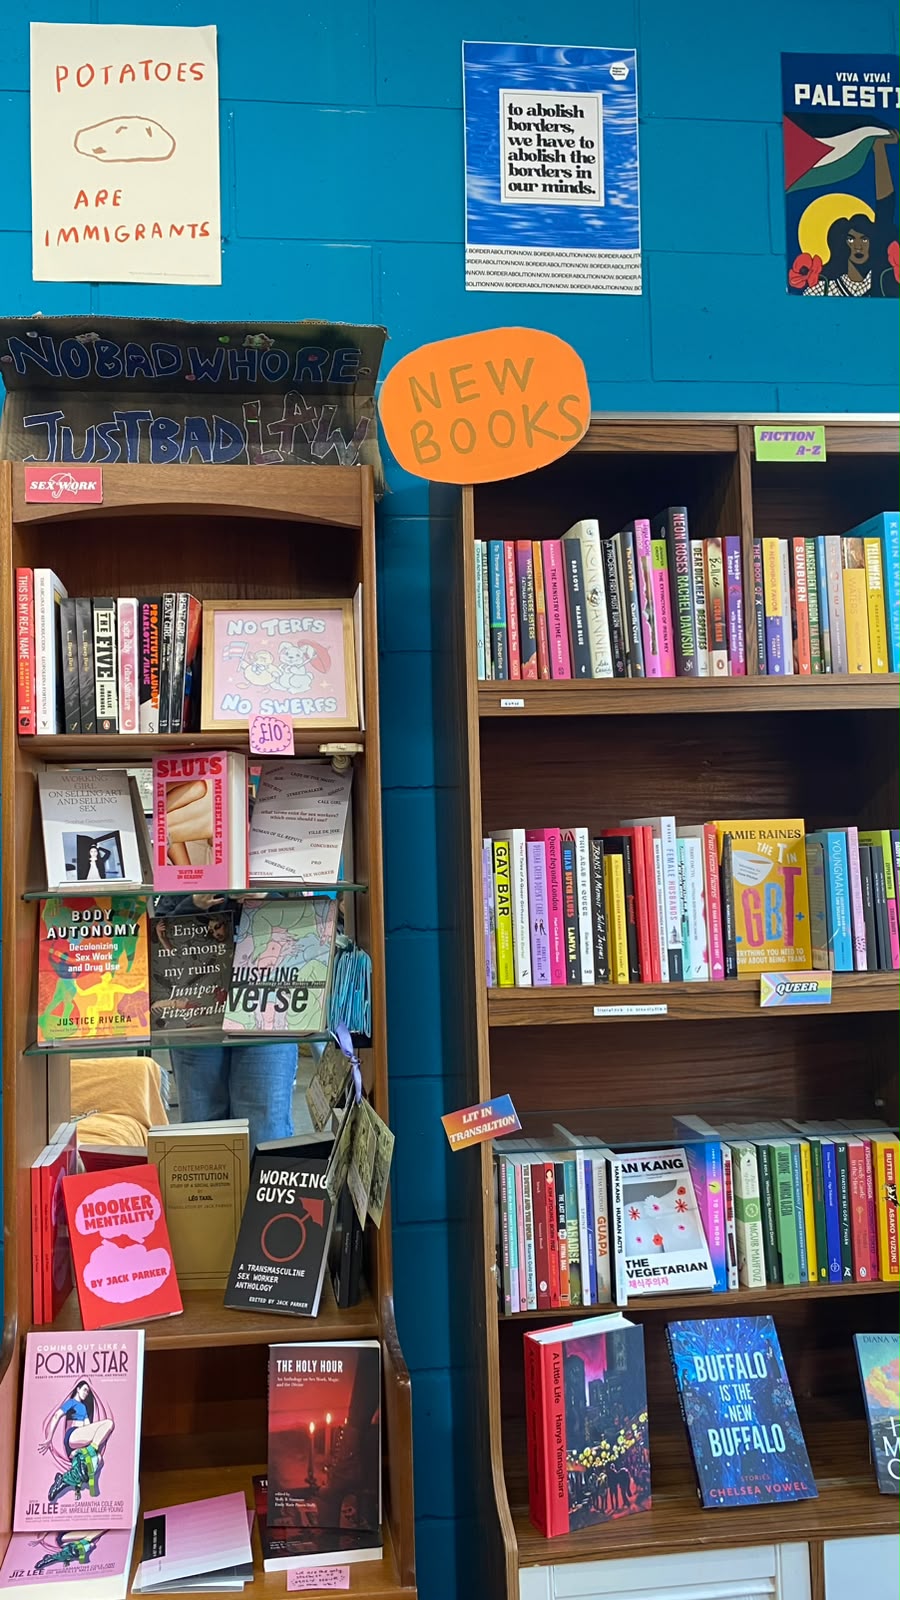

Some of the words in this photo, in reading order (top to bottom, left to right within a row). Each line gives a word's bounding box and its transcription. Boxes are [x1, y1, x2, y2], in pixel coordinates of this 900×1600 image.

[56, 59, 206, 93] POTATOES
[835, 72, 859, 82] VIVA
[863, 72, 891, 83] VIVA!
[507, 103, 523, 116] to
[526, 103, 585, 119] abolish
[507, 118, 575, 134] borders,
[507, 136, 533, 148] we
[535, 134, 576, 149] have
[578, 135, 595, 150] to
[507, 148, 566, 164] abolish
[569, 150, 597, 165] the
[507, 163, 573, 180] borders
[574, 165, 593, 180] in
[507, 181, 539, 193] our
[541, 180, 597, 196] minds.
[74, 189, 124, 210] ARE
[45, 221, 211, 247] IMMIGRANTS
[187, 347, 361, 383] WHORE
[408, 357, 535, 413] NEW
[242, 390, 372, 466] LAW
[410, 394, 583, 465] BOOKS
[759, 431, 816, 442] FICTION
[796, 444, 822, 456] A-Z
[30, 479, 55, 490] SEX
[56, 479, 97, 491] WORK
[673, 513, 686, 540] NEON
[675, 542, 688, 573] ROSES
[795, 546, 806, 602] SUNBURN
[18, 575, 28, 592] THIS
[18, 593, 28, 602] IS
[677, 576, 691, 613] RACHEL
[18, 603, 28, 616] MY
[19, 616, 29, 634] REAL
[100, 613, 108, 632] THE
[226, 619, 258, 636] NO
[261, 616, 326, 637] TERFS
[680, 616, 694, 656] DAWSON
[20, 638, 30, 659] NAME
[96, 636, 113, 678] FIVE
[150, 668, 159, 709] LAUNDRY
[220, 694, 253, 715] NO
[259, 697, 338, 715] SWERFS
[259, 723, 283, 744] £10
[156, 756, 222, 778] SLUTS
[61, 775, 109, 783] WORKING
[74, 782, 97, 790] GIRL
[65, 790, 104, 798] SELLING
[104, 789, 122, 797] ART
[156, 782, 164, 797] BY
[57, 798, 78, 806] AND
[79, 797, 118, 805] SELLING
[79, 804, 97, 812] SEX
[214, 778, 223, 839] MICHELLE
[157, 800, 165, 842] EDITED
[758, 829, 801, 840] RAINES
[215, 842, 223, 864] TEA
[548, 835, 556, 857] Queer
[756, 842, 773, 856] THE
[776, 842, 788, 864] T
[786, 852, 798, 864] IN
[496, 846, 508, 878] GAY
[550, 858, 558, 884] beyond
[832, 840, 844, 896] YOUNGMAN
[498, 884, 510, 917] BAR
[72, 909, 115, 923] BODY
[47, 924, 141, 940] AUTONOMY
[174, 924, 210, 938] Enjoy
[69, 942, 119, 952] Decolonizing
[158, 946, 178, 958] me
[182, 943, 226, 956] among
[76, 953, 91, 962] Sex
[92, 952, 113, 961] Work
[68, 964, 83, 972] and
[84, 963, 104, 973] Drug
[105, 962, 121, 972] Use
[164, 968, 185, 980] my
[188, 964, 222, 976] ruins
[231, 966, 299, 983] HUSTLING
[169, 984, 219, 1000] Juniper
[775, 982, 818, 996] QUEER
[229, 985, 309, 1013] verse
[160, 1001, 227, 1021] Fitzgerald
[57, 1016, 96, 1027] JUSTICE
[99, 1015, 132, 1024] RIVERA
[462, 1110, 480, 1124] LIT
[480, 1106, 492, 1118] IN
[449, 1114, 516, 1143] TRANSALTION
[172, 1164, 226, 1172] CONTEMPORARY
[641, 1158, 684, 1172] KANG
[171, 1172, 229, 1182] PROSTITUTION
[259, 1170, 328, 1190] WORKING
[256, 1186, 296, 1204] GUYS
[82, 1194, 154, 1218] HOOKER
[84, 1210, 154, 1230] MENTALITY
[567, 1219, 580, 1264] PARADISE
[597, 1216, 608, 1257] GUAPA
[248, 1264, 306, 1278] TRANSMASCULINE
[625, 1258, 650, 1269] THE
[626, 1262, 708, 1279] VEGETARIAN
[90, 1278, 104, 1288] BY
[106, 1274, 130, 1286] JACK
[132, 1267, 168, 1281] PARKER
[234, 1281, 274, 1292] ANTHOLOGY
[236, 1272, 250, 1281] SEX
[252, 1274, 279, 1284] WORKER
[36, 1344, 73, 1352] COMING
[35, 1352, 86, 1375] PORN
[92, 1350, 128, 1374] STAR
[276, 1360, 293, 1373] THE
[296, 1360, 318, 1373] HOLY
[320, 1360, 343, 1373] HOUR
[692, 1351, 768, 1384] BUFFALO
[718, 1384, 730, 1402] IS
[732, 1383, 754, 1401] THE
[728, 1404, 754, 1423] NEW
[555, 1414, 564, 1445] Hanya
[707, 1423, 786, 1458] BUFFALO
[556, 1445, 567, 1498] Yanagihara
[709, 1486, 762, 1498] CHELSEA
[766, 1481, 808, 1492] VOWEL
[26, 1502, 40, 1516] JIZ
[42, 1502, 59, 1514] LEE
